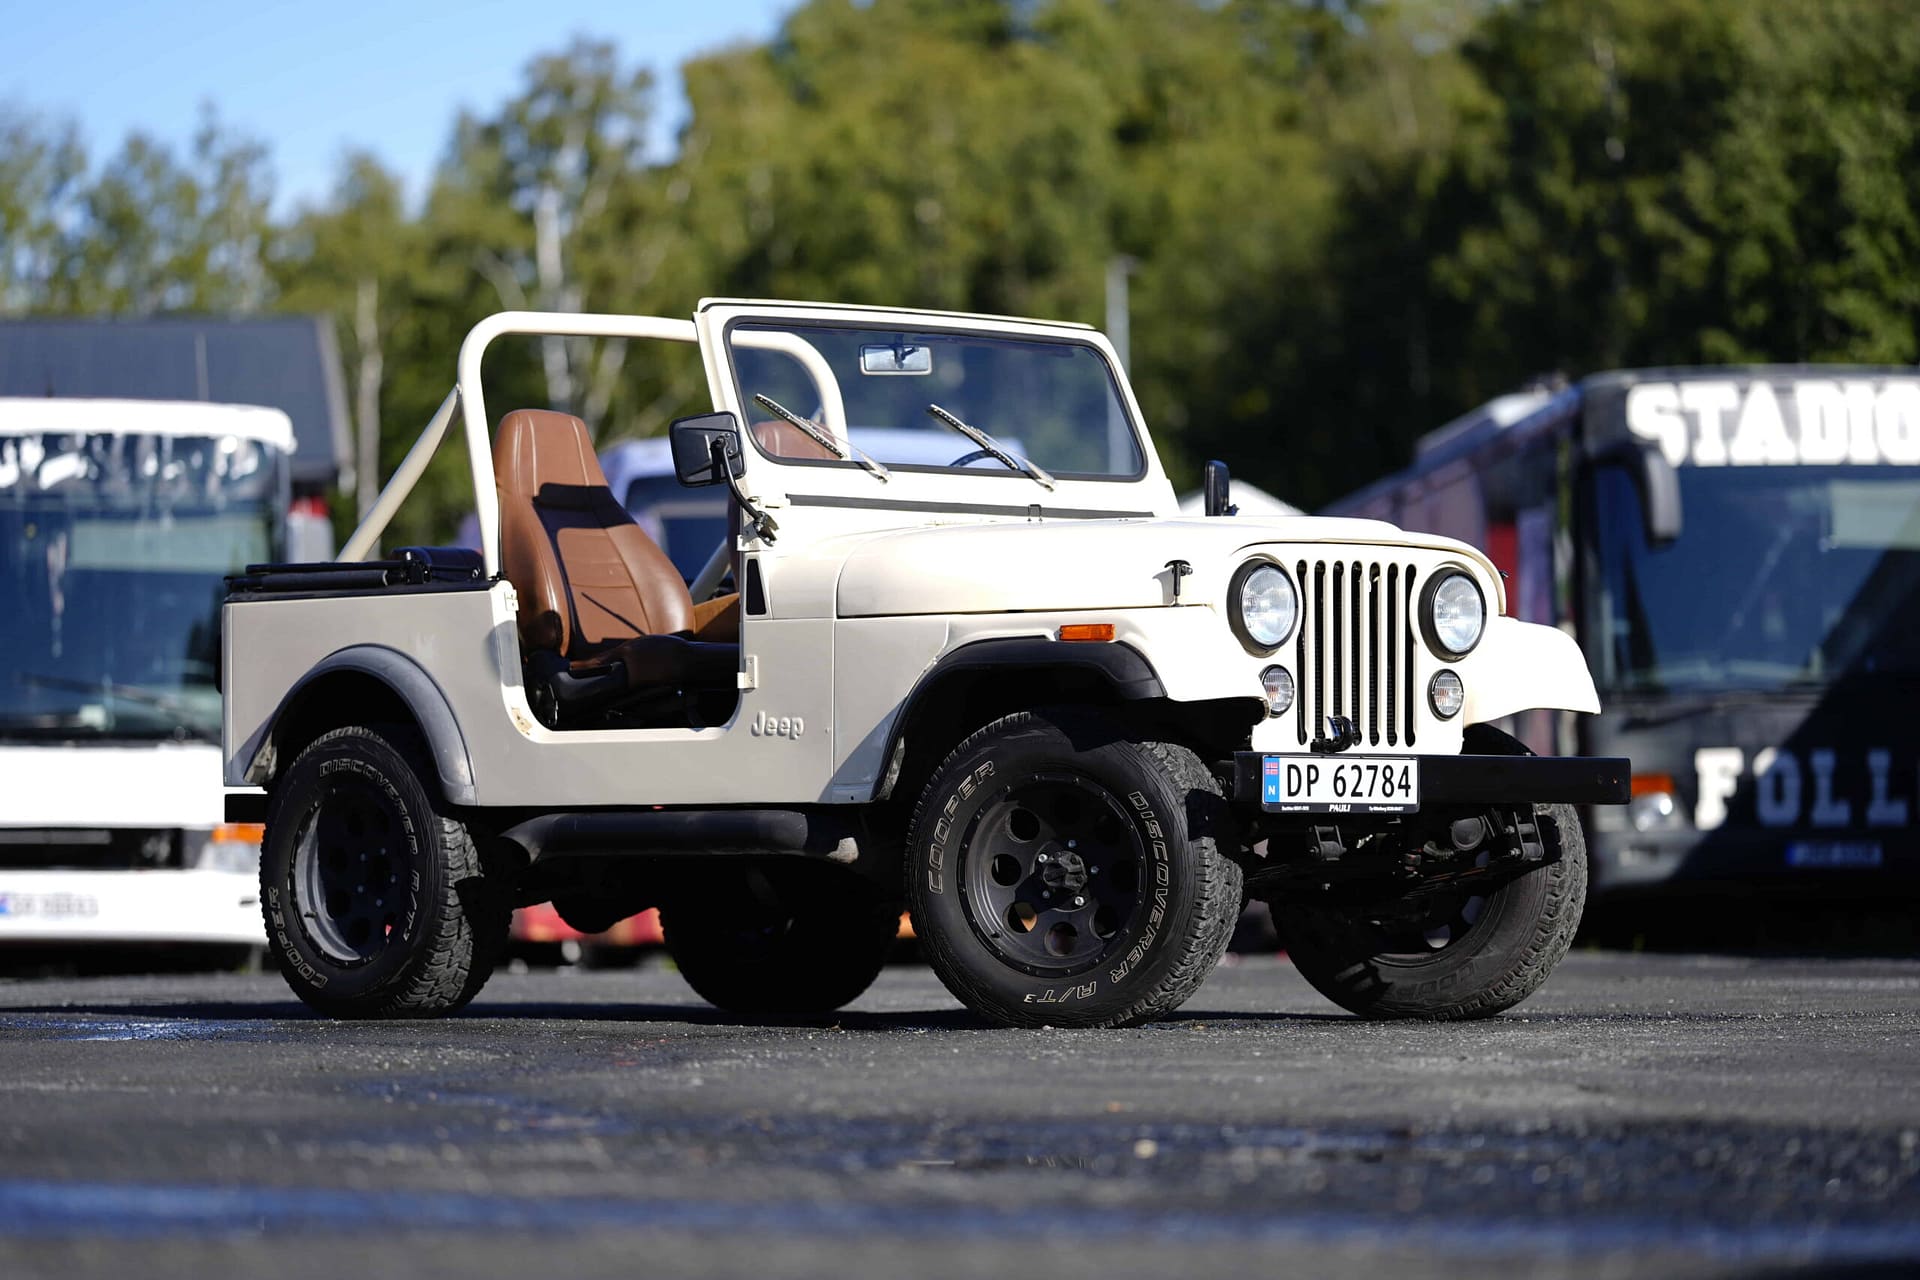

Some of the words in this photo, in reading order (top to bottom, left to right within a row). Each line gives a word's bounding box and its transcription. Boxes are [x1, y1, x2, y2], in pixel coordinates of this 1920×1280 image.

[1626, 380, 1920, 467] STADIO
[751, 711, 804, 740] Jeep
[319, 757, 419, 855] DISCOVERER
[1268, 785, 1276, 795] N
[1287, 764, 1319, 797] DP
[1333, 764, 1412, 798] 62784
[1328, 803, 1351, 813] PAULI
[1694, 746, 1920, 830] FOLL
[927, 760, 996, 895] COOPER
[1109, 791, 1169, 984] DISCOVERER
[268, 886, 329, 989] COOPER
